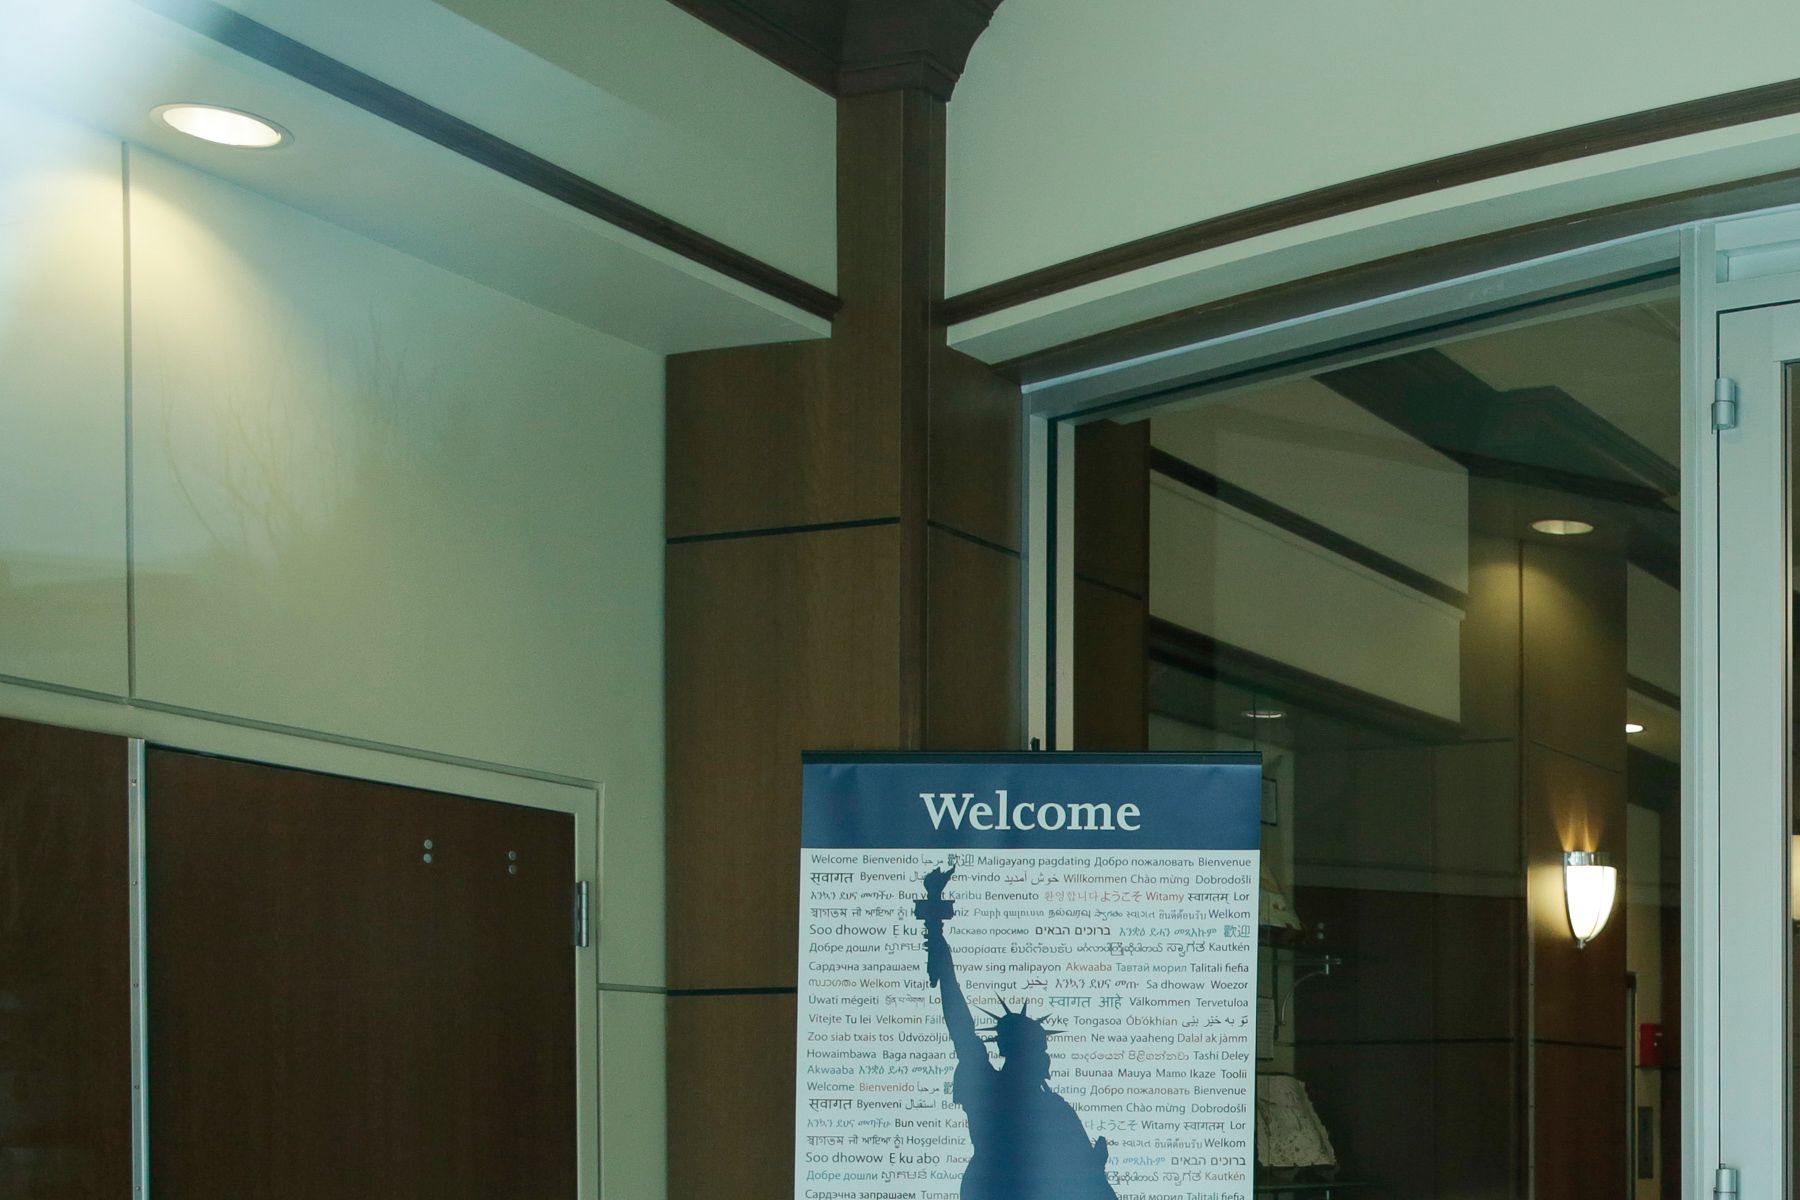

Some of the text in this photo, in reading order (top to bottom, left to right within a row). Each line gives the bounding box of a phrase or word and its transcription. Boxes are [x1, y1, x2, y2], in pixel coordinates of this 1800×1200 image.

[920, 790, 1141, 831] Welcome
[811, 854, 919, 864] Welcome Bienvenido
[977, 856, 1090, 868] Maligayang pagdating
[1094, 856, 1194, 869] Добро пожаловать
[1198, 857, 1251, 868] Bienvenue
[860, 871, 905, 883] Byenveni
[949, 873, 1000, 882] em-vindo
[1063, 873, 1127, 883] Willkommen
[1130, 873, 1157, 884] Chào
[1195, 872, 1252, 885] Dobrodošli
[899, 891, 921, 900] Bun
[949, 891, 1039, 901] Karibu Benvenuto
[1100, 891, 1143, 902] ようこそ
[1146, 891, 1184, 904] Witamy
[1234, 891, 1250, 902] Lor
[1208, 908, 1250, 919] Welkom
[810, 924, 887, 936] Soo dhowow
[949, 926, 1029, 937] Ласкаво просимо
[1035, 926, 1112, 936] ברוכים הבאים
[809, 942, 880, 954] Добре дошли
[1209, 942, 1250, 952] Kautkén
[809, 961, 920, 973] Сардэчна запрашаем
[985, 961, 1112, 976] sing malipayon Akwaaba
[1115, 963, 1187, 975] Тавтай морил
[1190, 963, 1249, 973] Talitali fiefia
[860, 978, 900, 989] Welkom
[966, 980, 1017, 993] Benvingut
[1145, 979, 1248, 990] Sa dhowaw Woezor
[967, 995, 1044, 1010] Selamat datang
[1129, 996, 1248, 1008] Välkommen Tervetuloa
[845, 1015, 857, 1024] Tu
[860, 1014, 872, 1024] lei
[875, 1014, 922, 1024] Velkomin
[1073, 1016, 1121, 1028] Tongasoa
[808, 1032, 894, 1042] Zoo siab txais tos
[1091, 1032, 1105, 1043] Ne
[1107, 1034, 1128, 1042] waa
[1130, 1033, 1174, 1045] yaaheng
[1177, 1032, 1203, 1043] Dalal
[1205, 1033, 1218, 1044] ak
[807, 1048, 946, 1063] Howaimbawa Baga nagaan
[1193, 1051, 1249, 1063] Tashi Deley
[1075, 1067, 1247, 1080] Buunaa Mauya Mamo Ikaze Toolii
[906, 1135, 965, 1147] Hoşgeldiniz
[898, 1152, 913, 1164] ku
